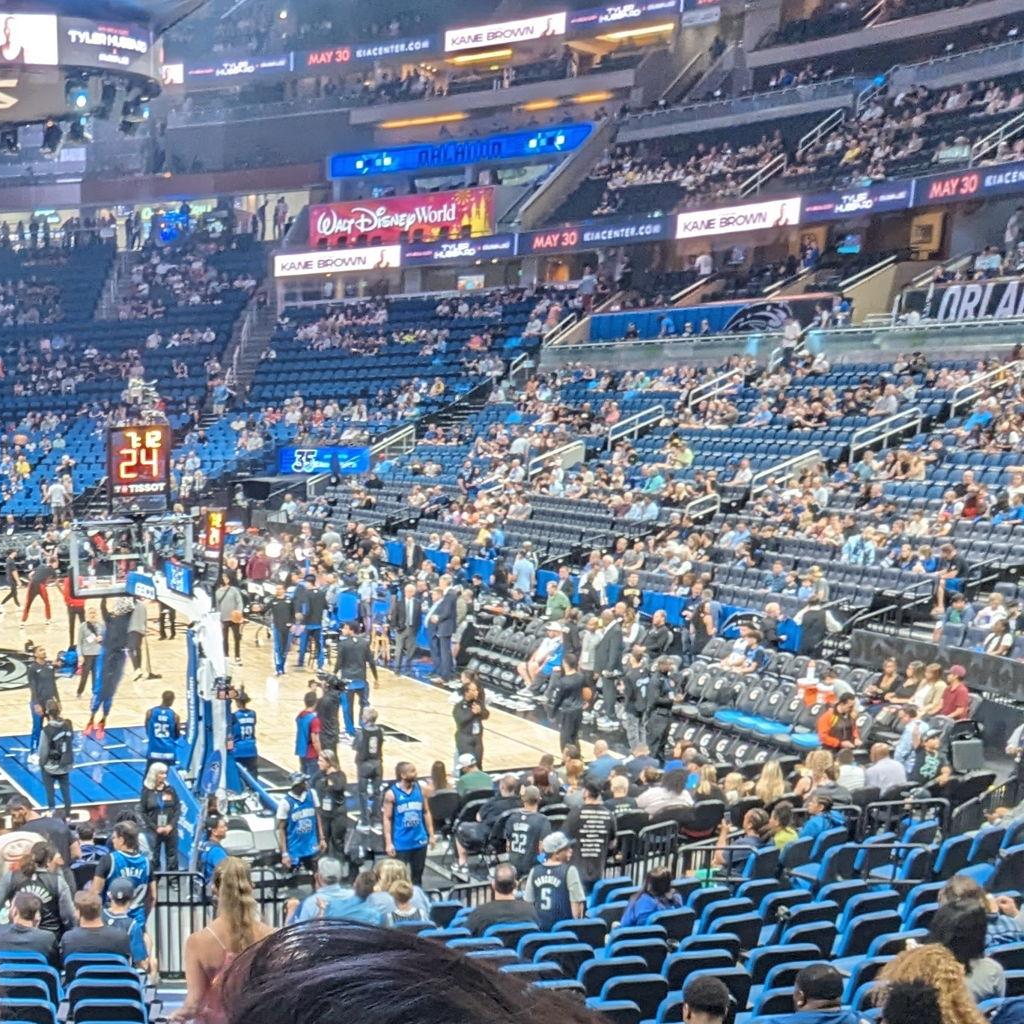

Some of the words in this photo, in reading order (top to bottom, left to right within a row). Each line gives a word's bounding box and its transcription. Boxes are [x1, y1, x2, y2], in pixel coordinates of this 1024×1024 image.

[451, 33, 482, 46] KANE
[487, 26, 534, 41] BROWN
[308, 51, 333, 65] MAY
[334, 49, 350, 62] 30
[356, 39, 429, 58] KIACENTER.COM
[929, 177, 960, 198] MAY
[960, 174, 977, 194] 30
[415, 203, 456, 223] World
[683, 220, 715, 232] KANE
[719, 211, 767, 228] BROWN
[533, 235, 561, 249] MAY
[561, 232, 577, 246] 30
[583, 224, 660, 241] KIACENTER.COM
[281, 261, 313, 272] KANE
[317, 257, 367, 269] BROWN
[119, 448, 159, 479] 24
[128, 482, 166, 493] TISSOT
[540, 887, 552, 910] 5
